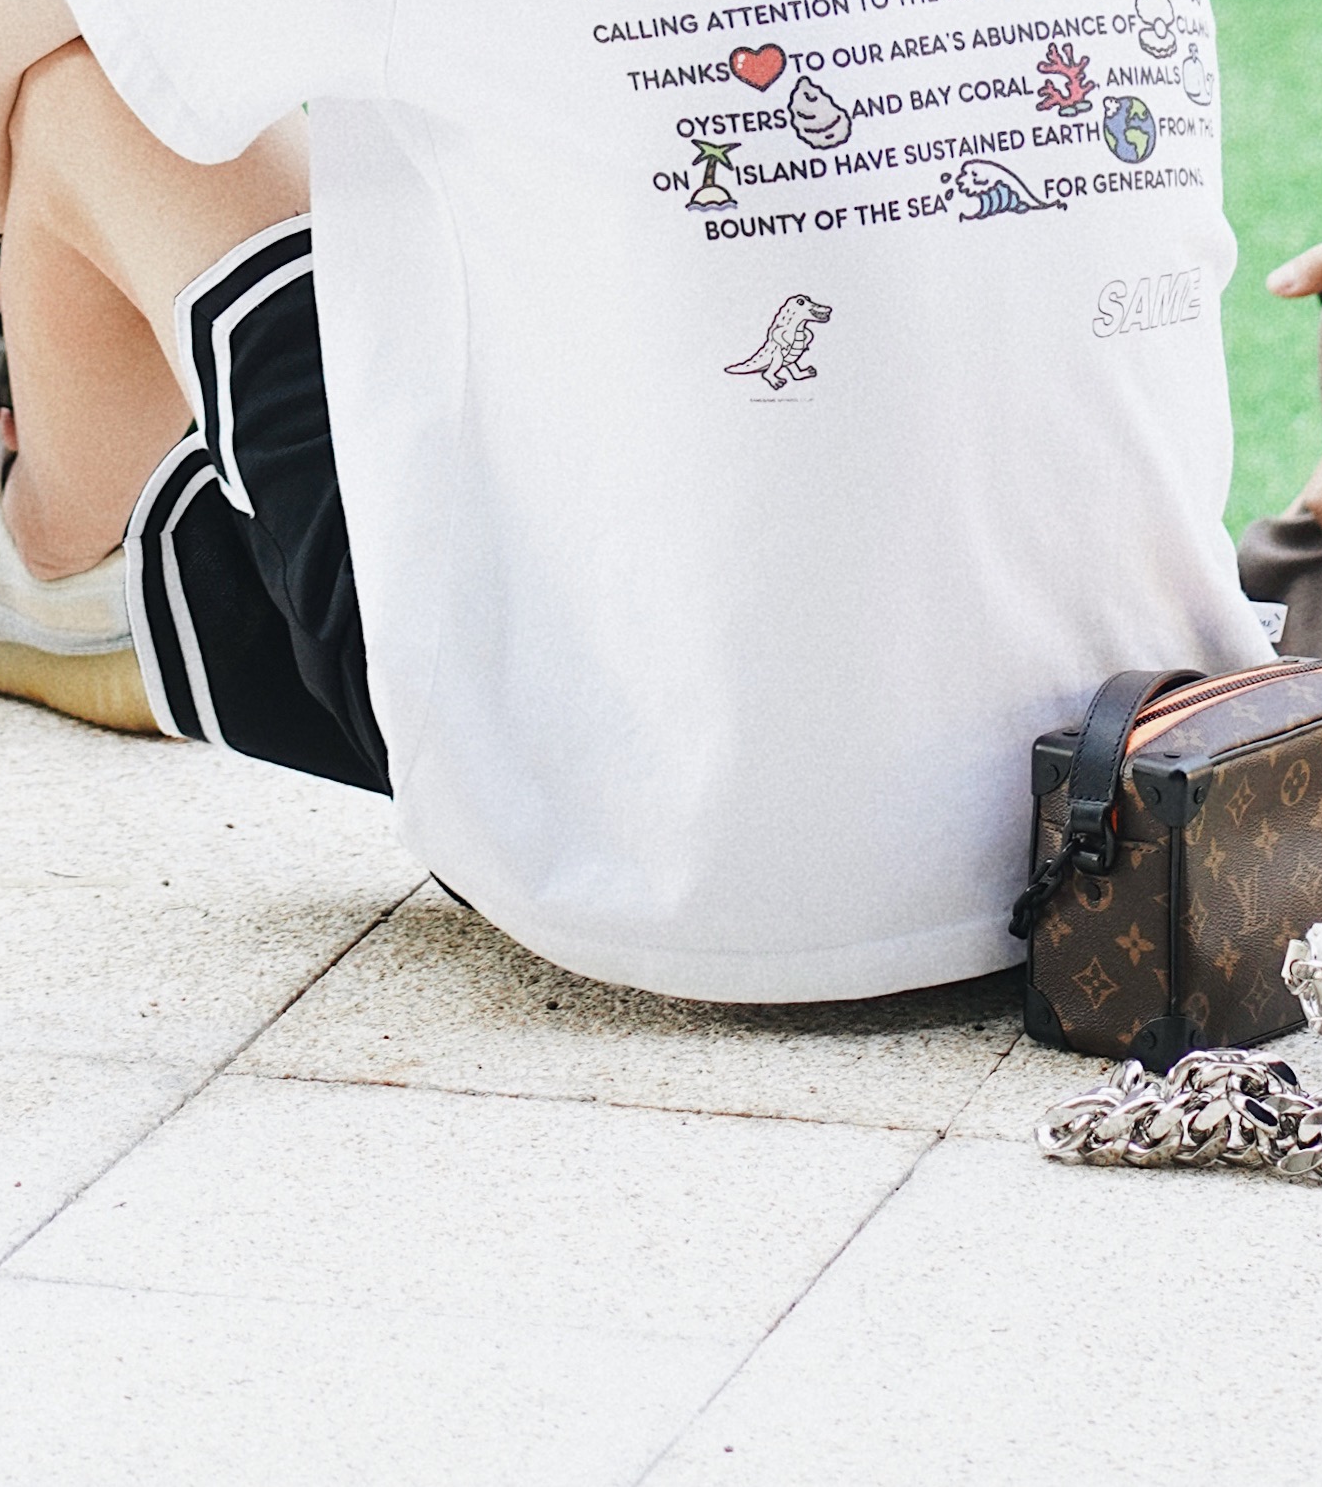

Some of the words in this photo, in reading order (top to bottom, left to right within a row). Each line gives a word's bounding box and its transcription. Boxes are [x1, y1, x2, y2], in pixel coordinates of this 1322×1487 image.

[593, 13, 698, 43] CALLING
[627, 62, 730, 91] THANKS
[789, 52, 824, 73] TO
[832, 43, 884, 68] OUR
[890, 31, 965, 60] AREA'S
[972, 15, 1107, 49] ABUNDANCE
[1112, 14, 1137, 34] OF
[676, 109, 787, 138] OYSTERS
[852, 94, 903, 120] AND
[910, 87, 952, 111] BAY
[958, 76, 1034, 103] CORAL
[1106, 67, 1181, 87] ANIMALS
[653, 171, 689, 191] ON
[735, 157, 827, 186] ISLAND
[835, 144, 897, 176] HAVE
[904, 129, 1025, 165] SUSTAINED
[1032, 121, 1101, 147] EARTH
[1158, 116, 1196, 137] FROM
[705, 212, 807, 240] BOUNTY
[814, 209, 847, 231] OF
[854, 200, 902, 226] THE
[907, 193, 947, 219] SEA
[1045, 177, 1088, 199] FOR
[1092, 267, 1200, 339] SAME
